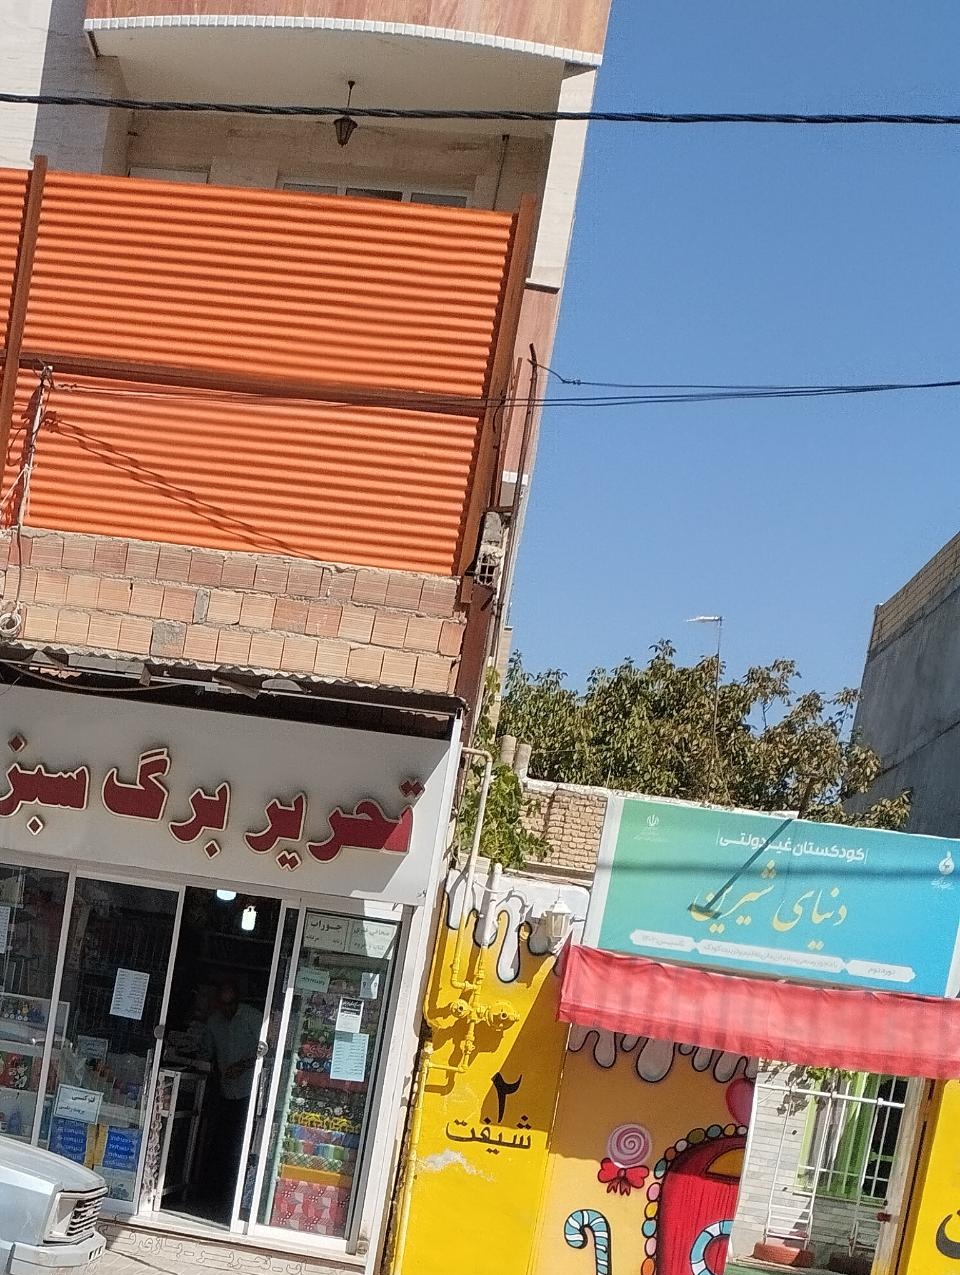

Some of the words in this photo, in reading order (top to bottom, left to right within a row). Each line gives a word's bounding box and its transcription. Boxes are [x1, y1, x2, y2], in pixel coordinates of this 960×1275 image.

[102, 748, 230, 860] برگ
[245, 778, 426, 871] تحریر
[792, 841, 865, 863] کودکستان
[689, 859, 775, 934] شیرین
[773, 887, 848, 950] دنیای
[310, 920, 342, 933] جوراب
[491, 1072, 523, 1124] ۲
[445, 1115, 532, 1155] شیفت
